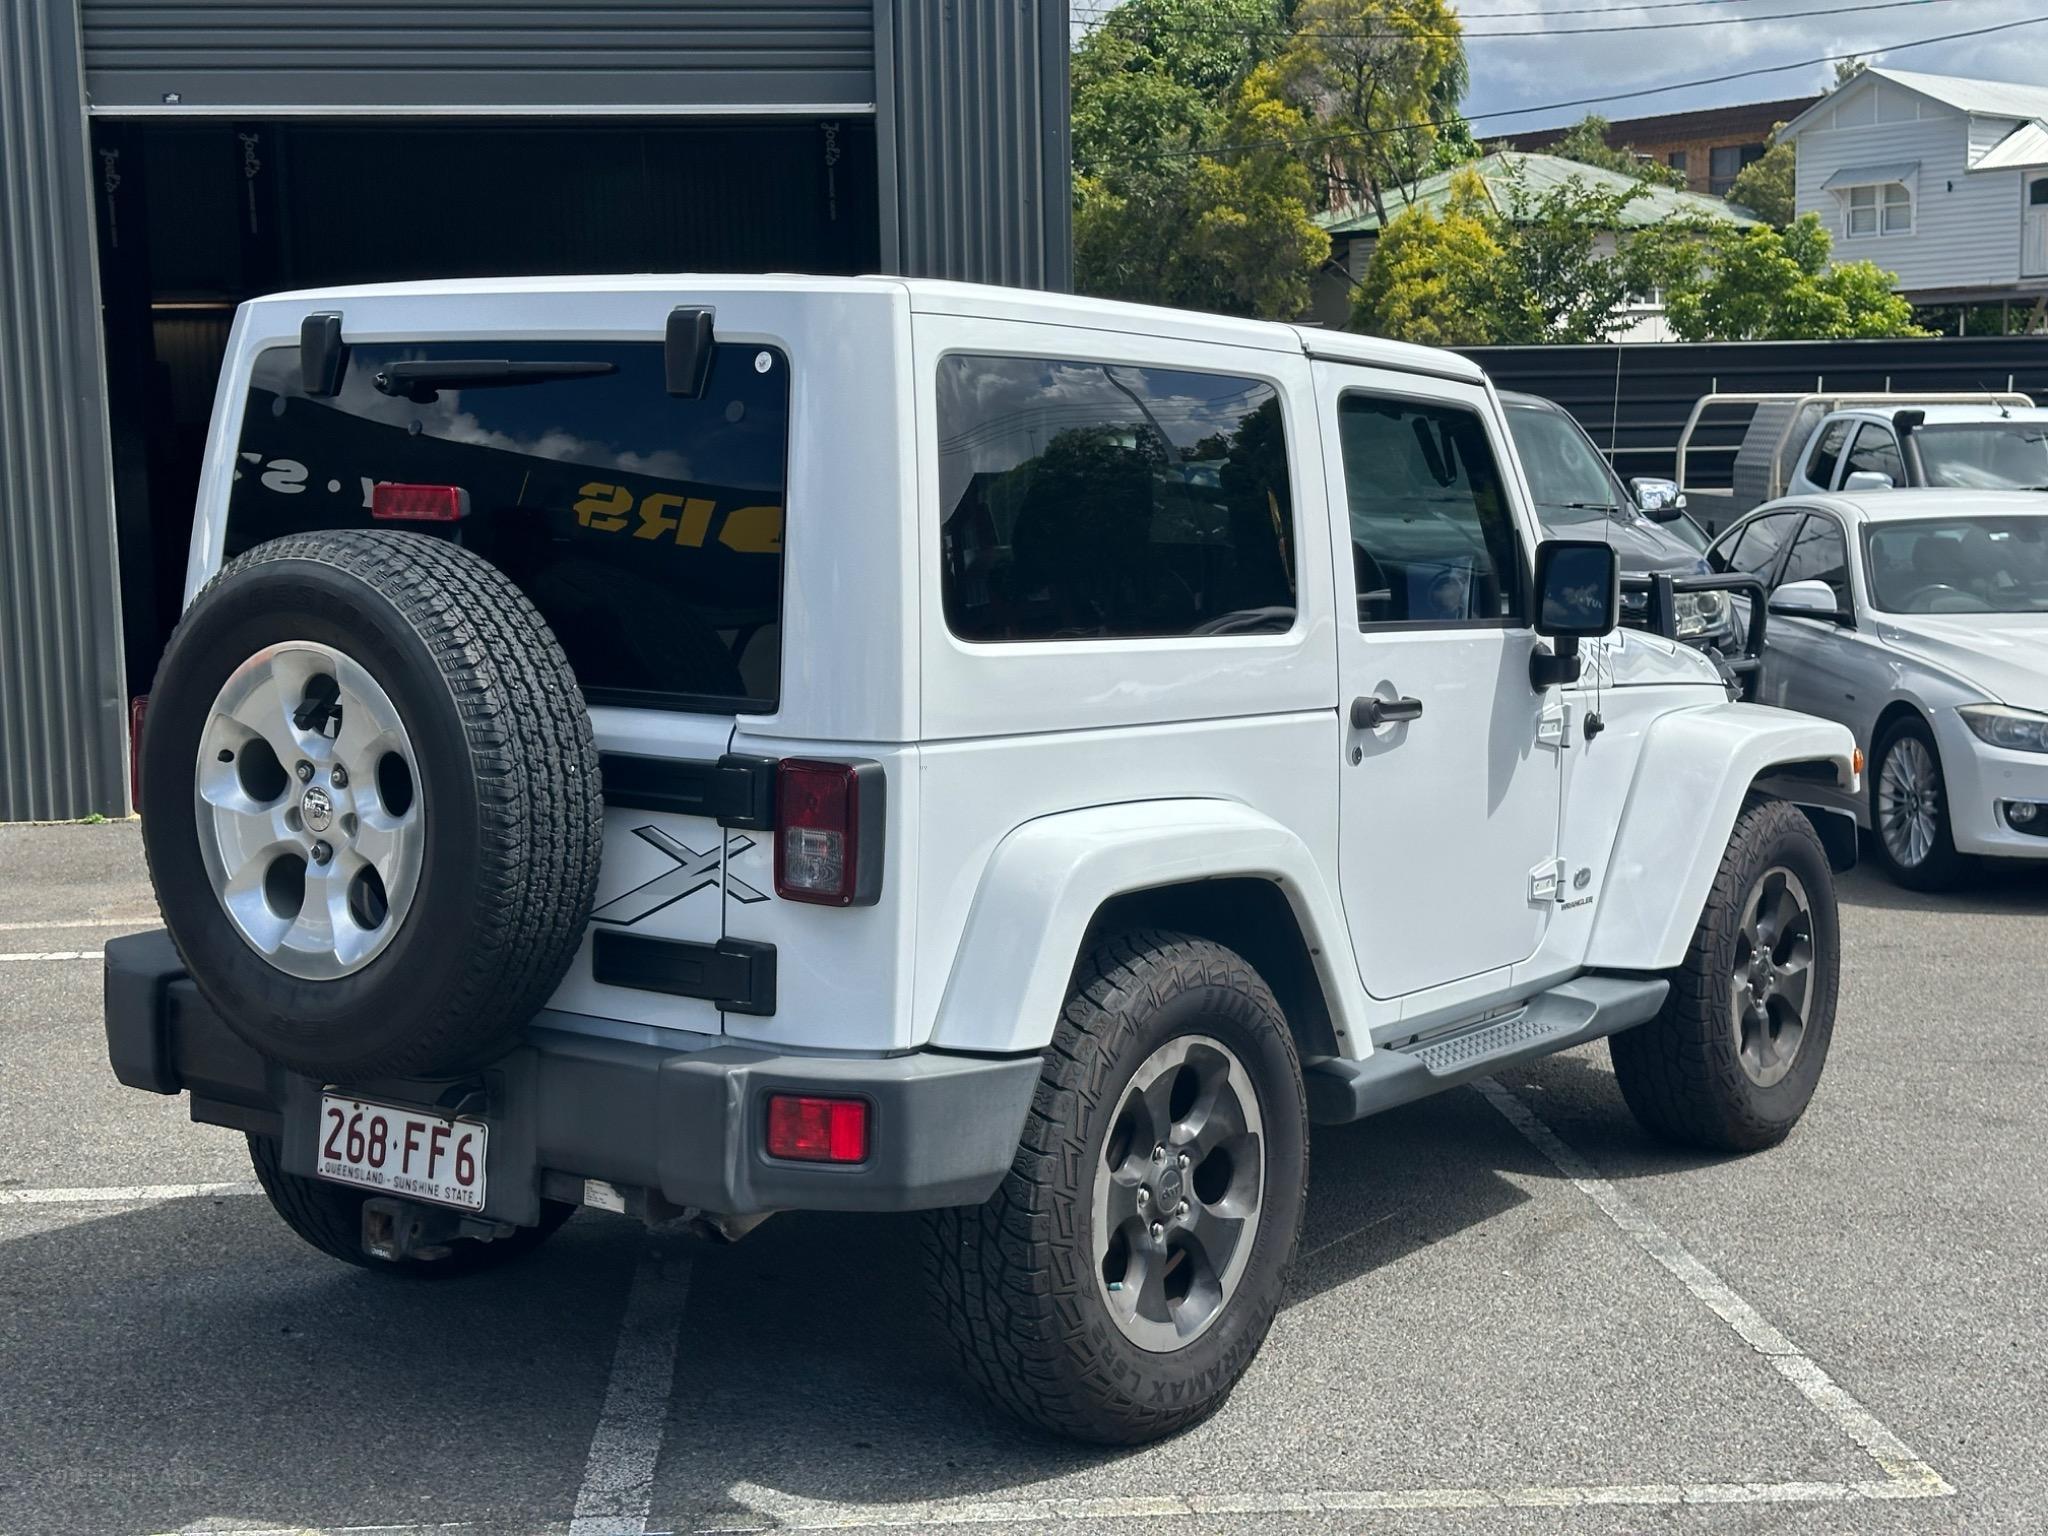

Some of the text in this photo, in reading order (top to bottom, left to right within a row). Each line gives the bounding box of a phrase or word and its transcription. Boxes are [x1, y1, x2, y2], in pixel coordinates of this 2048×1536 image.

[324, 1162, 385, 1185] QUEENSLAND
[393, 1175, 439, 1197] SUNSHINE
[444, 1186, 474, 1204] STATE
